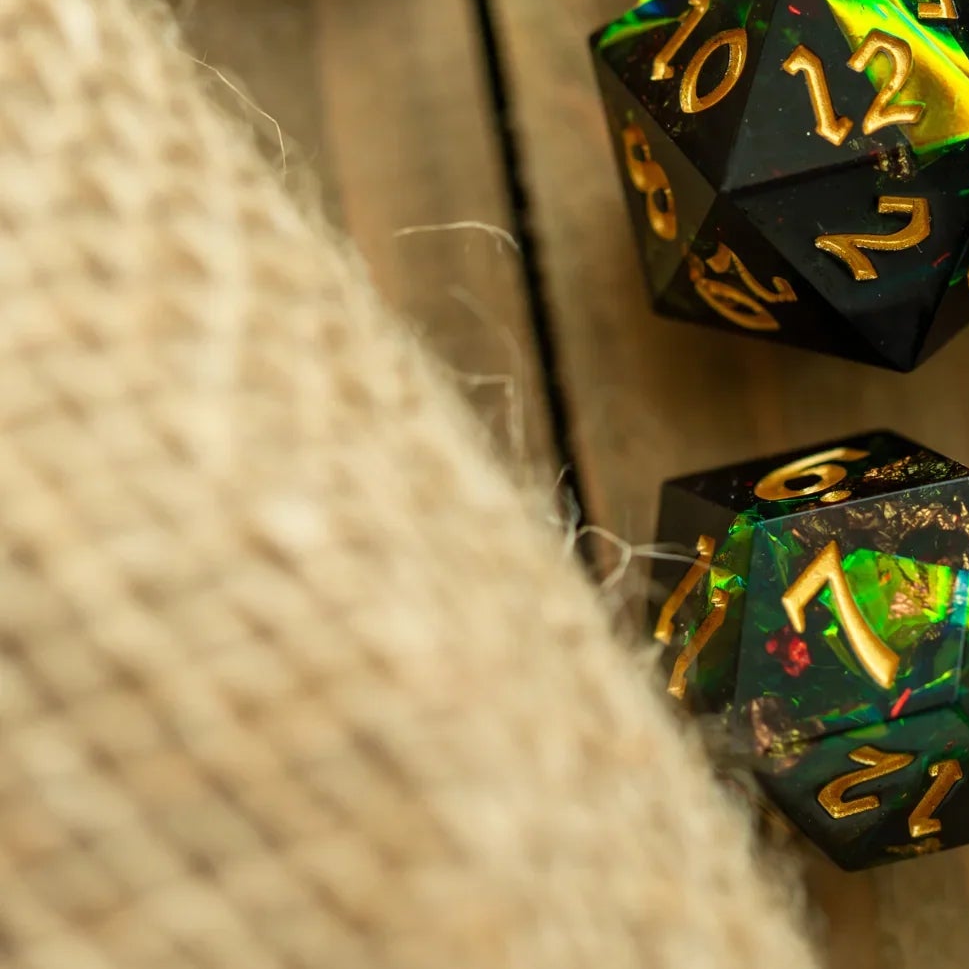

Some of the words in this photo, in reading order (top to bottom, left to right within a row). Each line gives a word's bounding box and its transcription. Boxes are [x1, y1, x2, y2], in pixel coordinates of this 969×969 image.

[782, 28, 925, 147] 12
[623, 124, 677, 240] 8
[814, 196, 932, 281] 2
[782, 540, 899, 689] 7
[817, 746, 963, 838] 12
